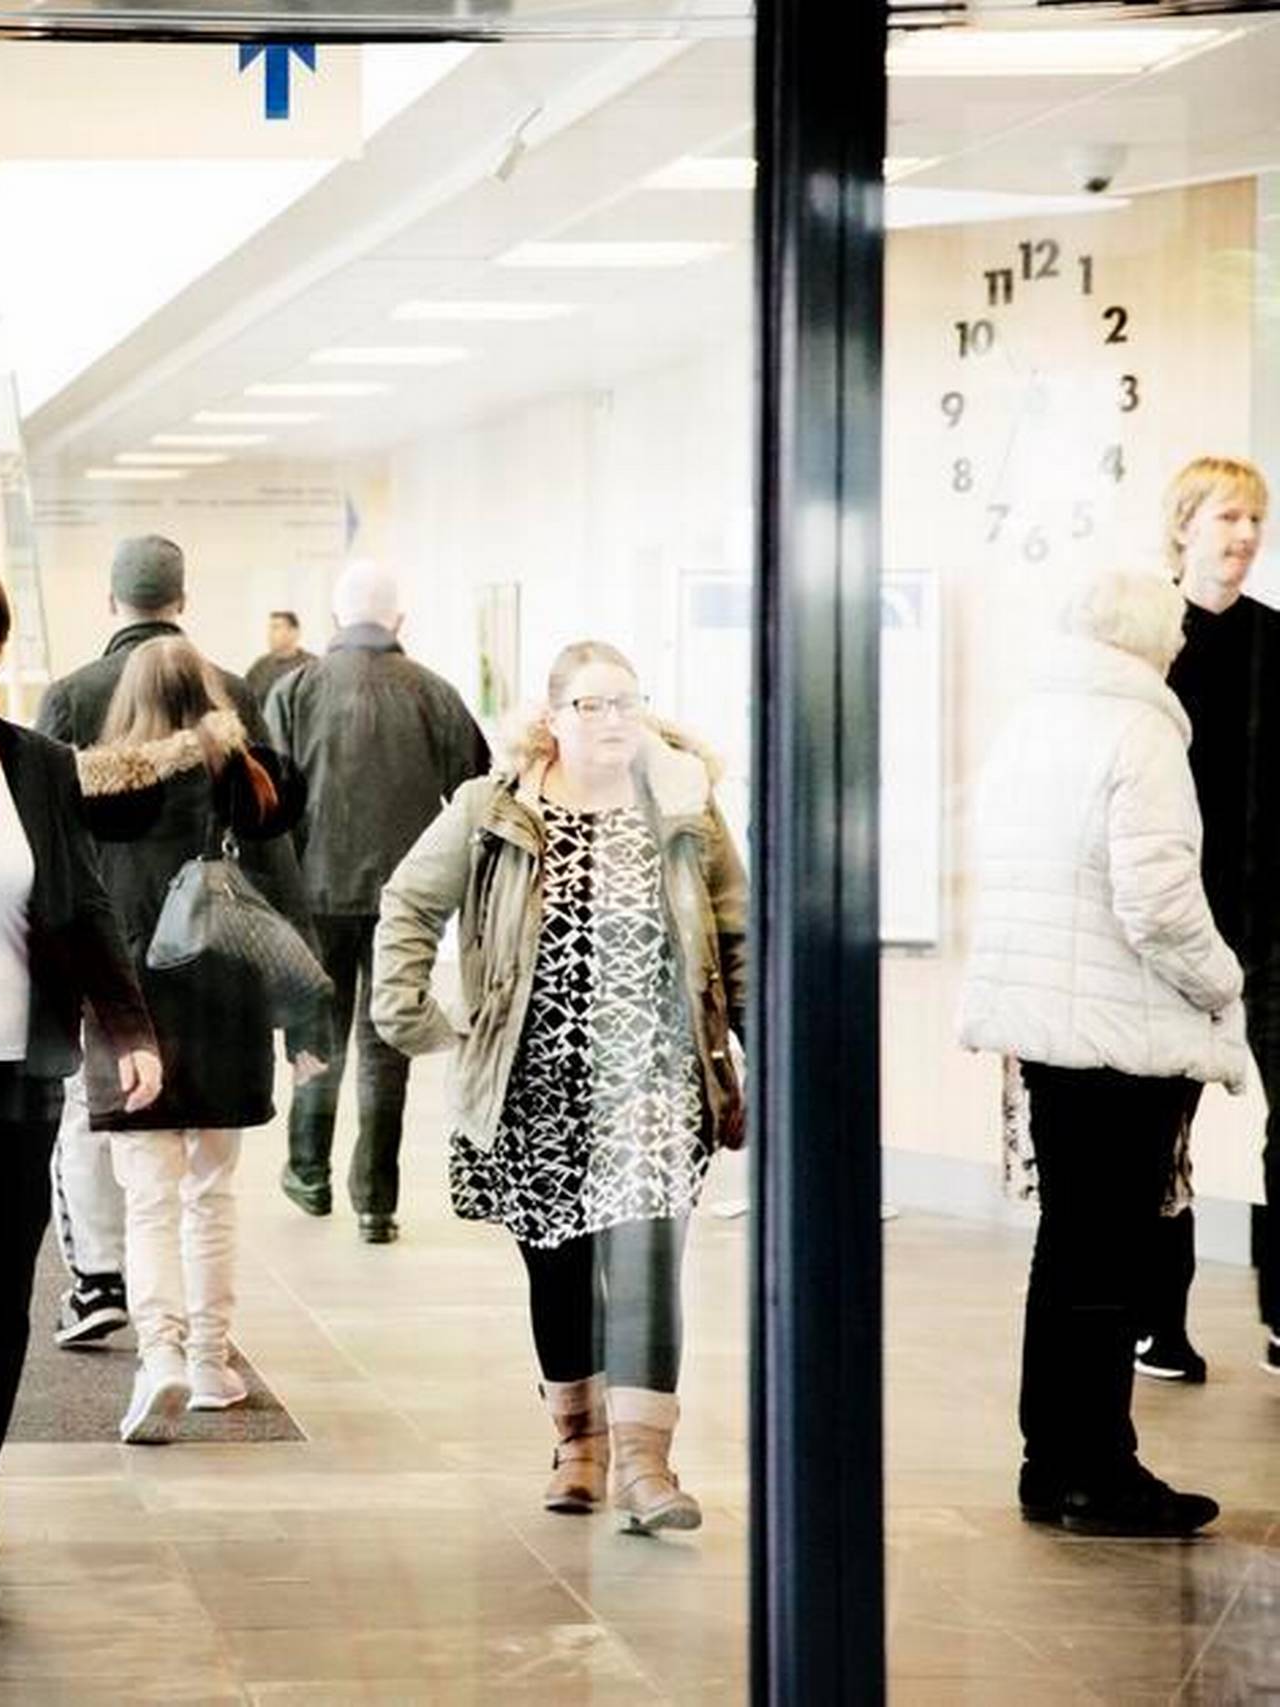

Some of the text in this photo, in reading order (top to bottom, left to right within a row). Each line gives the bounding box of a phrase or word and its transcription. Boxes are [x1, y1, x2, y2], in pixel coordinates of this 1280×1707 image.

[1018, 238, 1060, 281] 12
[1078, 255, 1094, 295] 1
[983, 267, 1014, 306] 11
[954, 319, 995, 358] 10
[1102, 306, 1128, 344] 2
[940, 391, 964, 428] 9
[1119, 374, 1140, 413] 3
[951, 457, 972, 493] 8
[1102, 443, 1126, 483] 4
[986, 503, 1010, 543] 7
[1071, 500, 1094, 539] 5
[1024, 524, 1050, 562] 6
